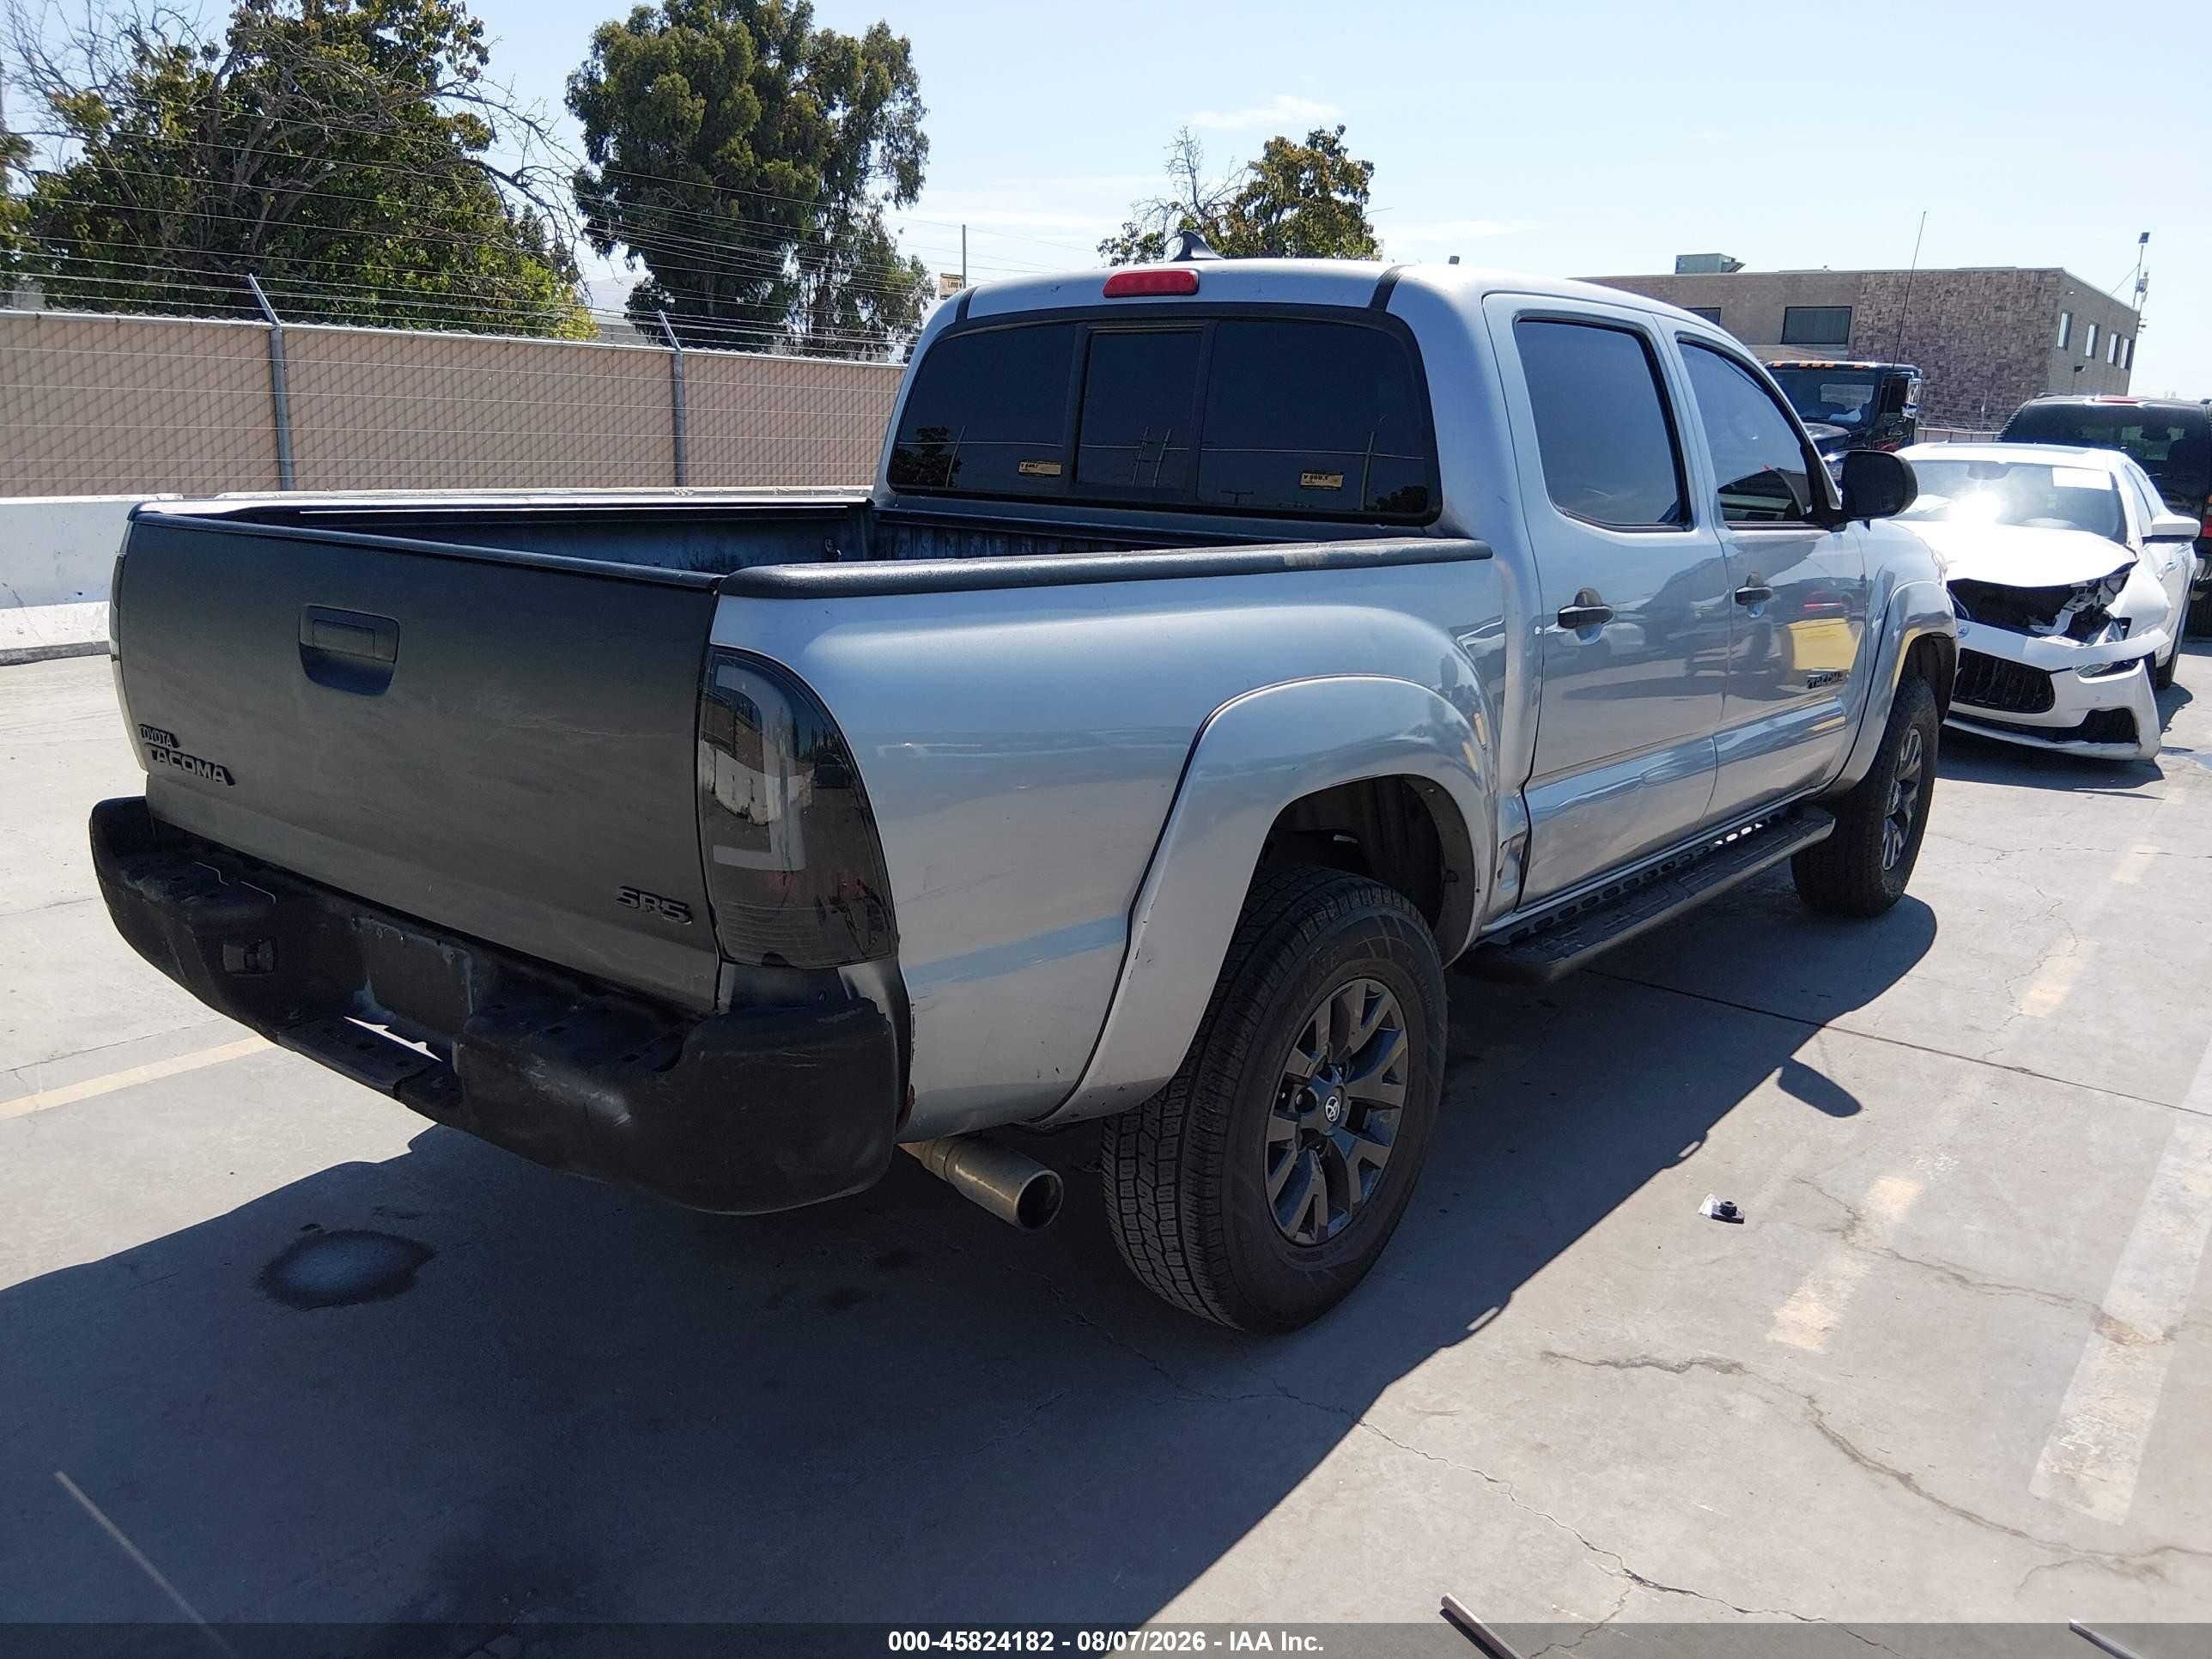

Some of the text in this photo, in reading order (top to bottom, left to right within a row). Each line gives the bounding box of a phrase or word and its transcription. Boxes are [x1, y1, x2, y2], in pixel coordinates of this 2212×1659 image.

[138, 724, 178, 749] TOYOTA
[145, 744, 232, 785] TACOMA
[616, 886, 692, 924] SR5
